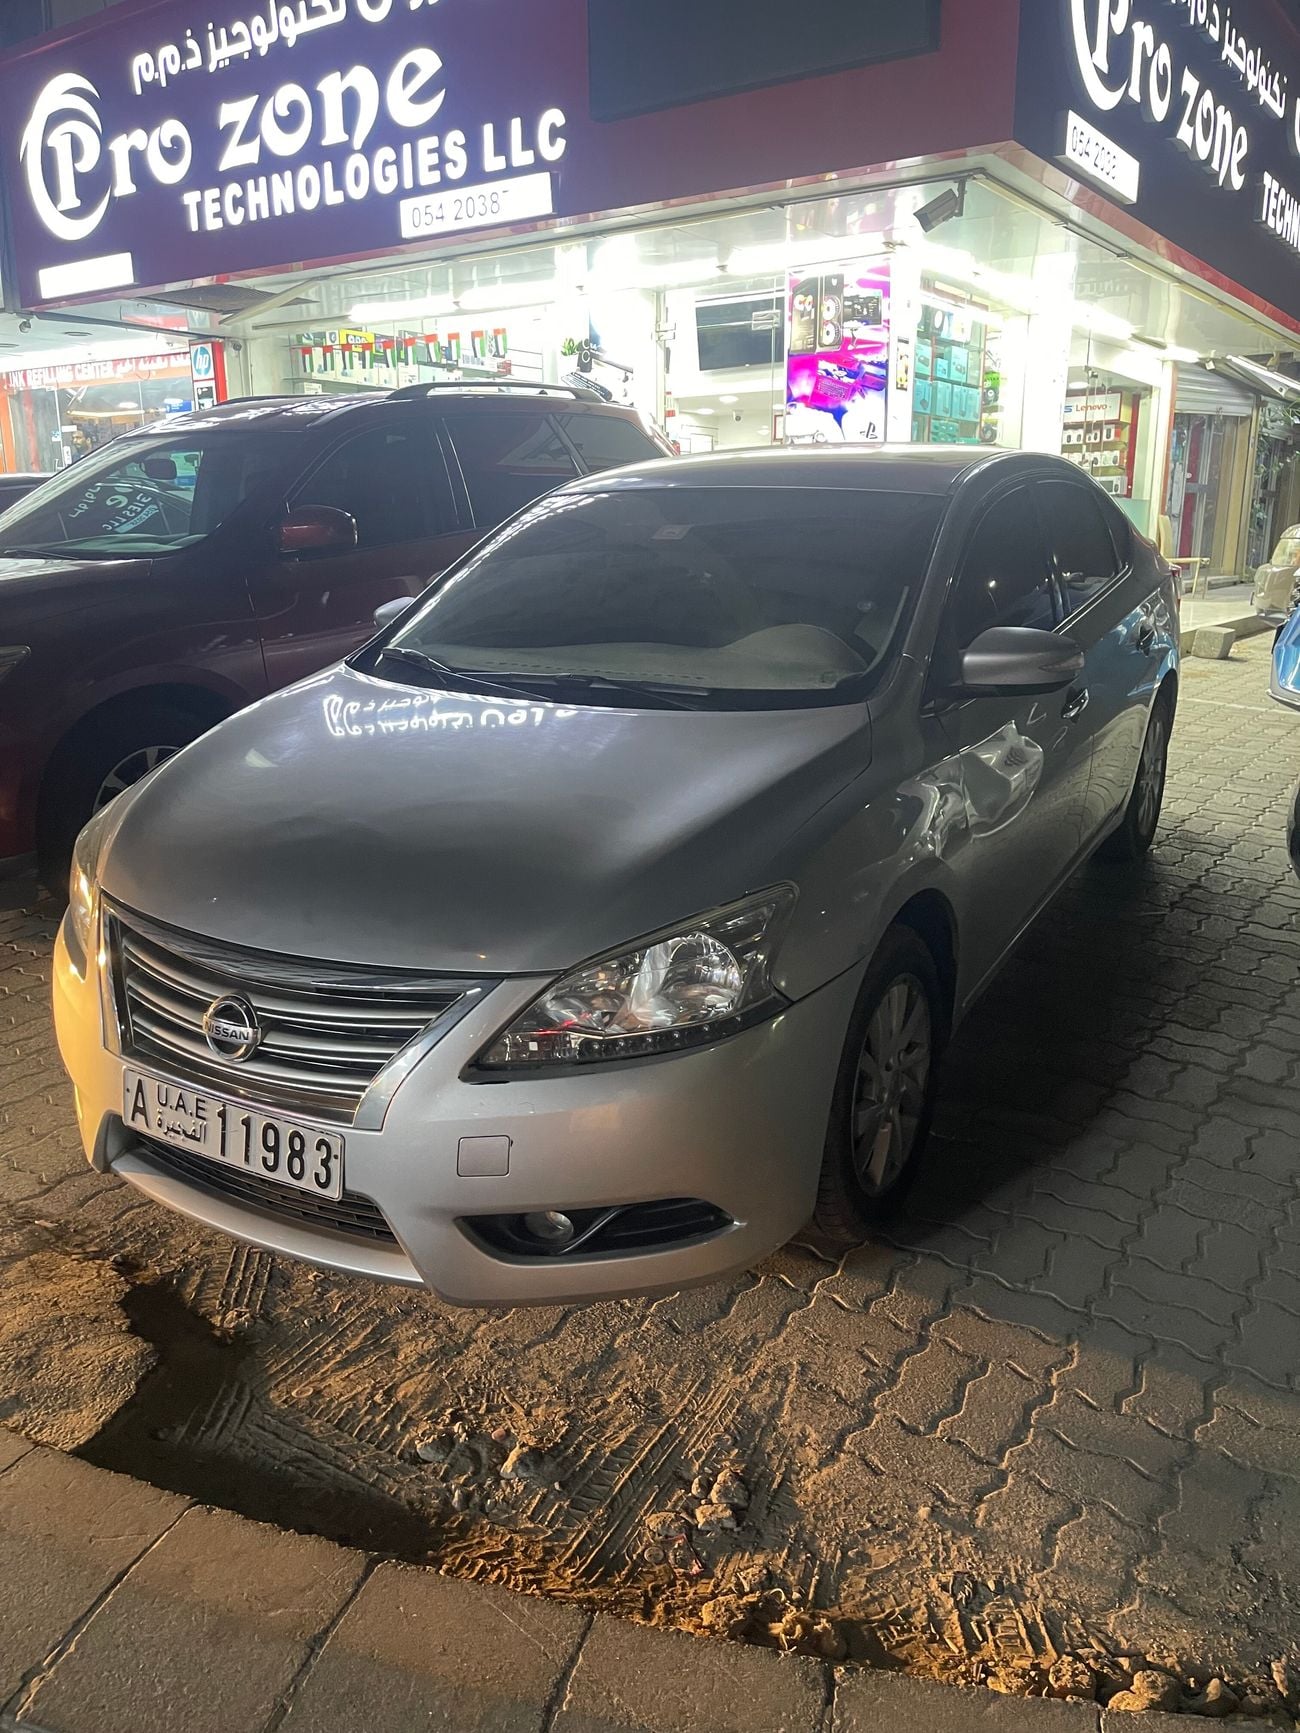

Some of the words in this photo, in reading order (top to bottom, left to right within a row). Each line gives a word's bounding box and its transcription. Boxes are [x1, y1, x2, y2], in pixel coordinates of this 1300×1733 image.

[218, 47, 446, 173] zone
[1176, 65, 1248, 191] zone
[182, 135, 468, 232] TECHNOLOGIES
[483, 108, 567, 174] LLC
[412, 202, 445, 228] 054
[454, 189, 509, 221] 2038
[1261, 170, 1300, 253] TECHN
[75, 361, 114, 381] CENTER
[194, 347, 212, 376] hp
[1075, 404, 1108, 412] Lenovo
[204, 1021, 250, 1042] NISSAN
[131, 1078, 150, 1129] A
[156, 1082, 207, 1121] U.A.E
[155, 1108, 207, 1145] الفجيرة
[216, 1103, 332, 1190] 11983
